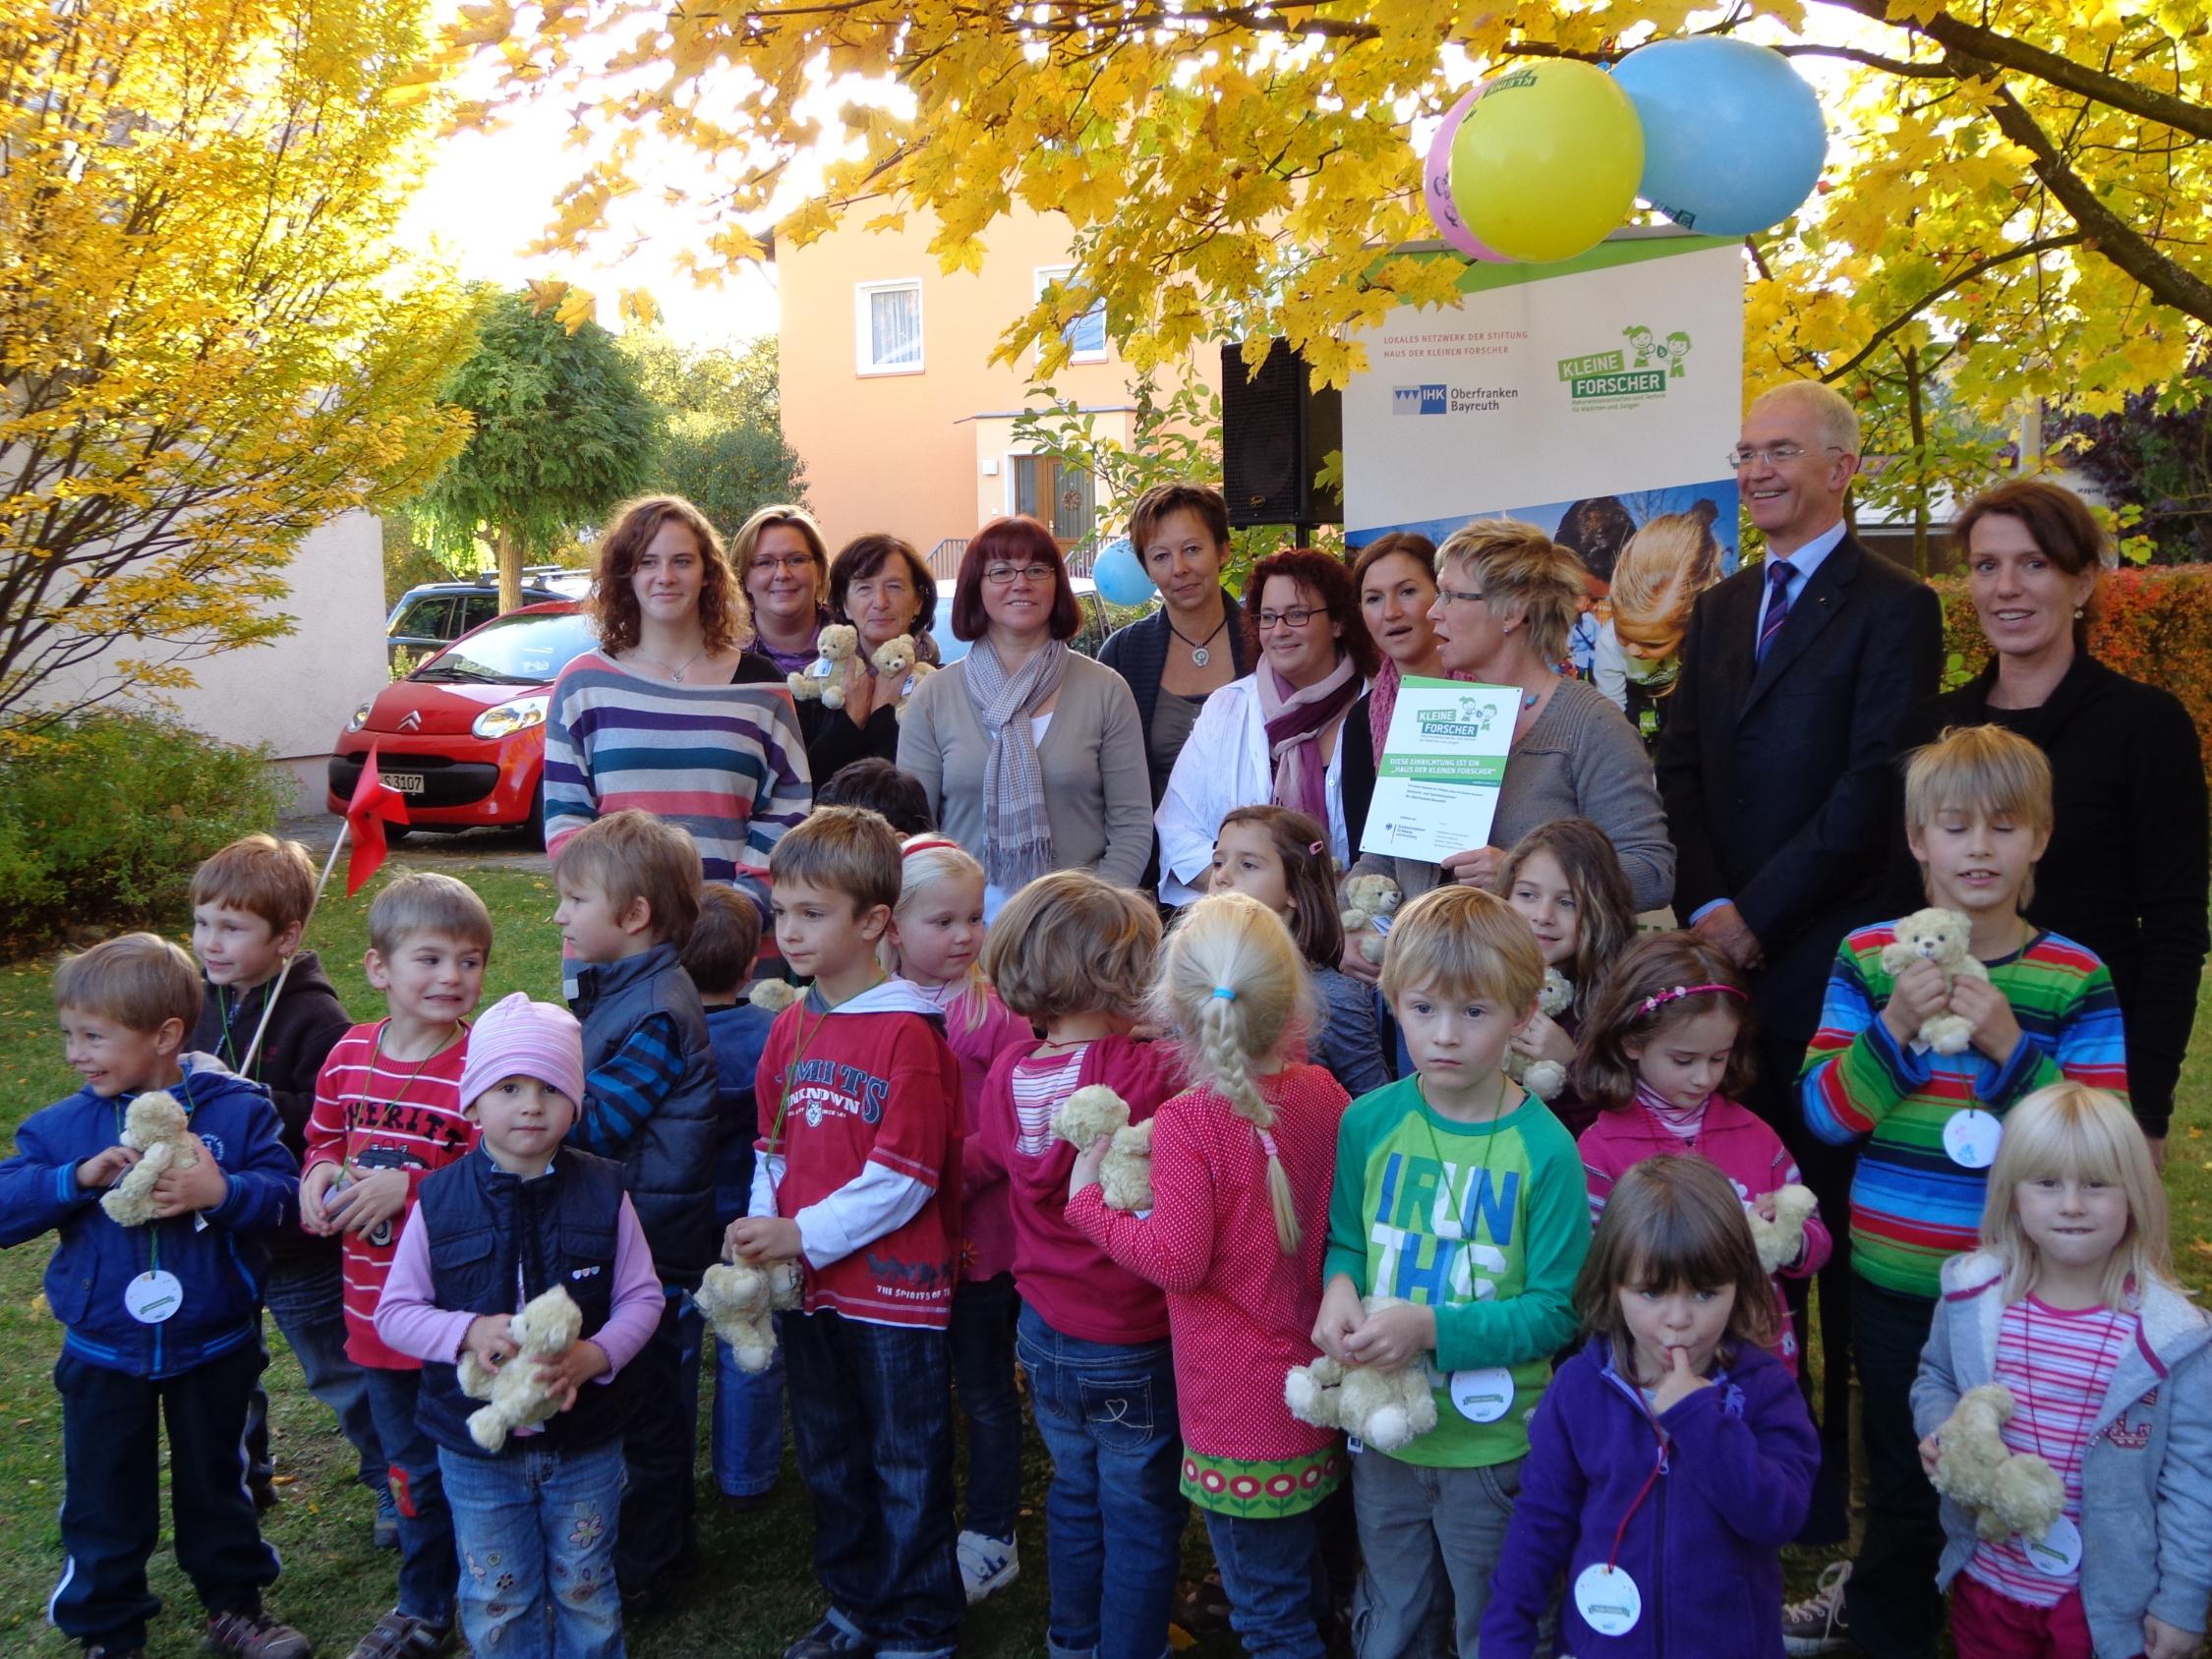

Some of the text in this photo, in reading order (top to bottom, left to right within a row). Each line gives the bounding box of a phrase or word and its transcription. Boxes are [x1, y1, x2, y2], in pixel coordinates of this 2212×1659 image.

[1384, 331, 1528, 345] LOKALES NETZWERK DER STIFTUNG
[1465, 346, 1508, 355] FORSCHER
[1562, 354, 1619, 377] KLEINE
[1576, 374, 1660, 395] FORSCHER
[1423, 388, 1445, 400] IHK
[1451, 387, 1518, 399] Oberfranken
[1451, 400, 1499, 413] Bayreuth
[1420, 711, 1453, 720] KLEINE
[1425, 722, 1476, 735] FORSCHER
[393, 775, 422, 790] 3107
[876, 1285, 893, 1296] THE
[895, 1288, 930, 1300] SPIRITS
[932, 1289, 942, 1298] OF
